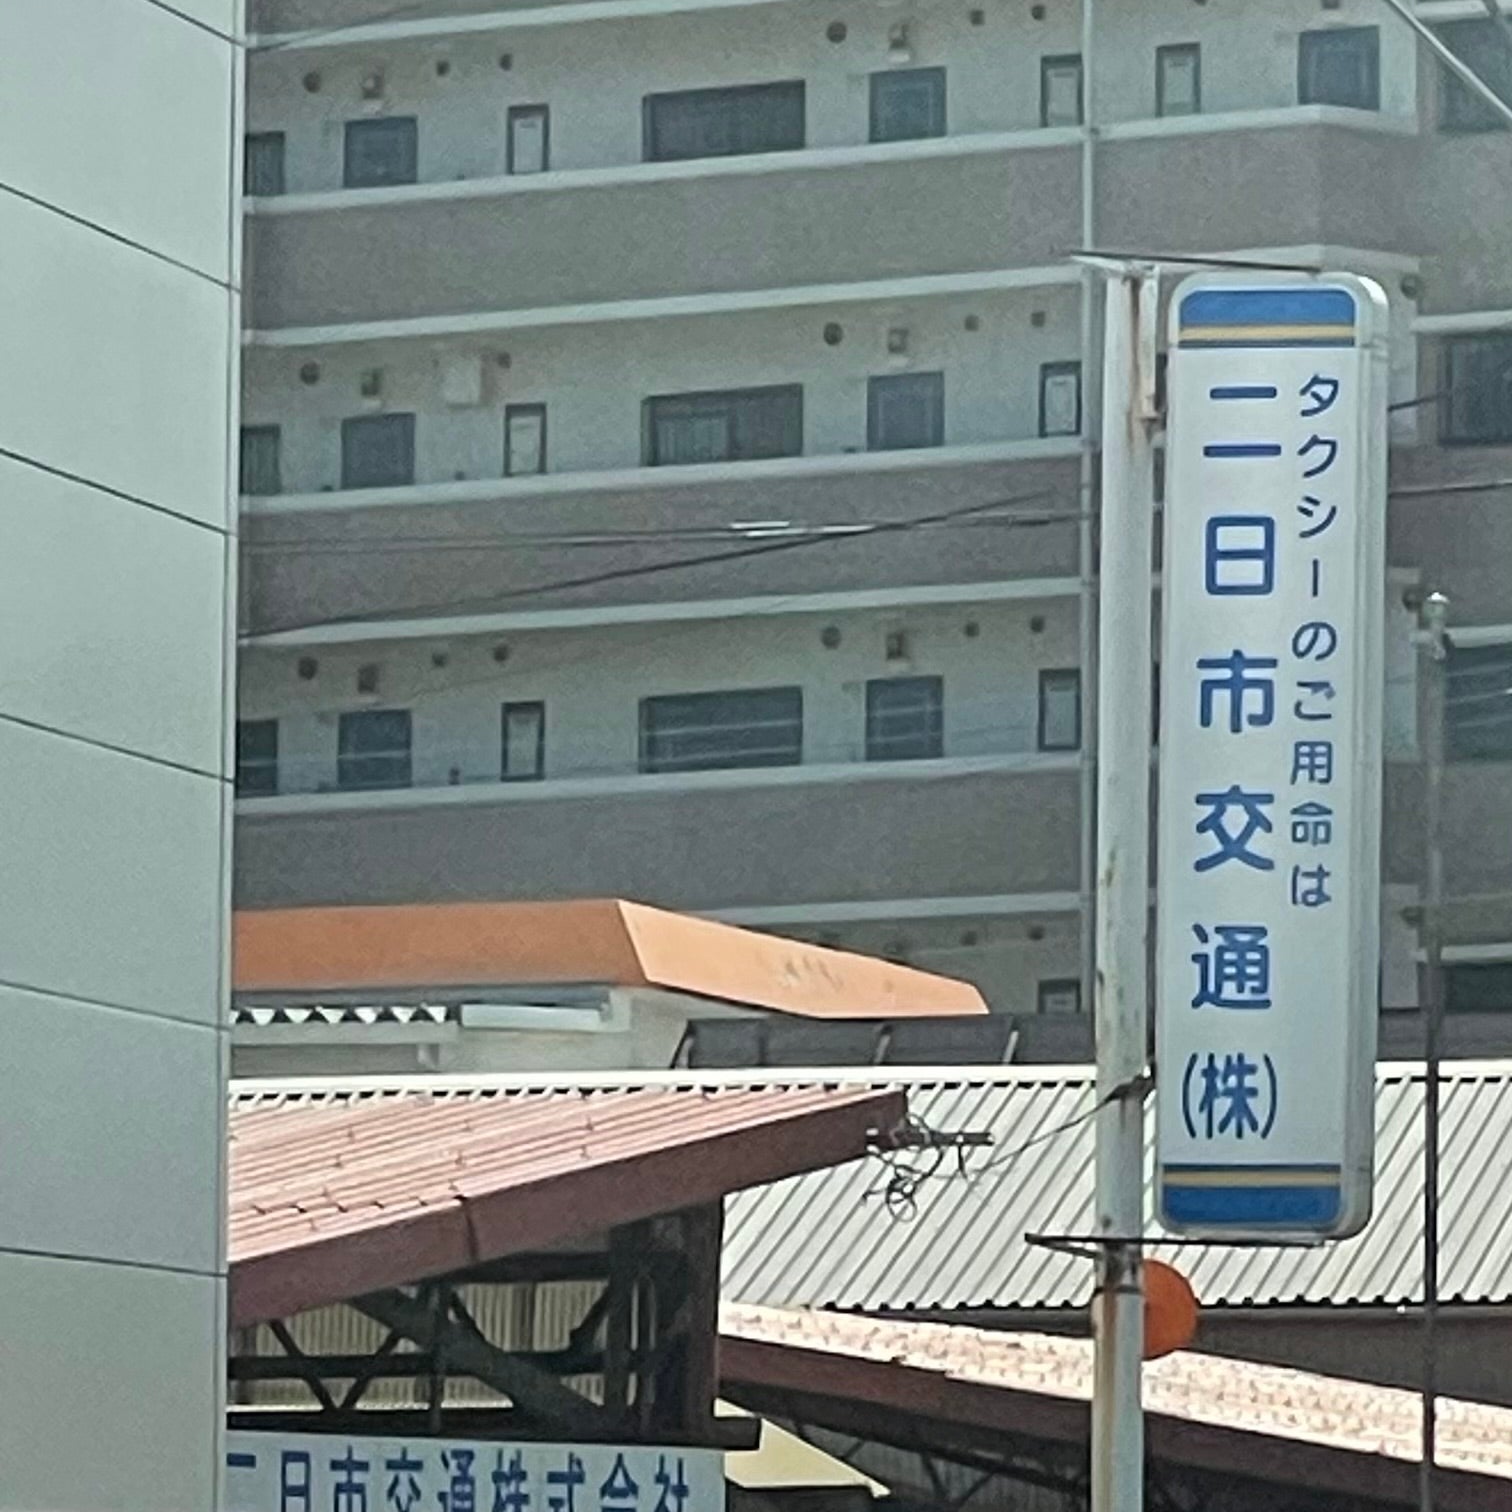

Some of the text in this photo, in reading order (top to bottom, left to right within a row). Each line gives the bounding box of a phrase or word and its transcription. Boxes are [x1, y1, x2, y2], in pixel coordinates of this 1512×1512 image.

[1289, 372, 1341, 910] タクシーのご用命は
